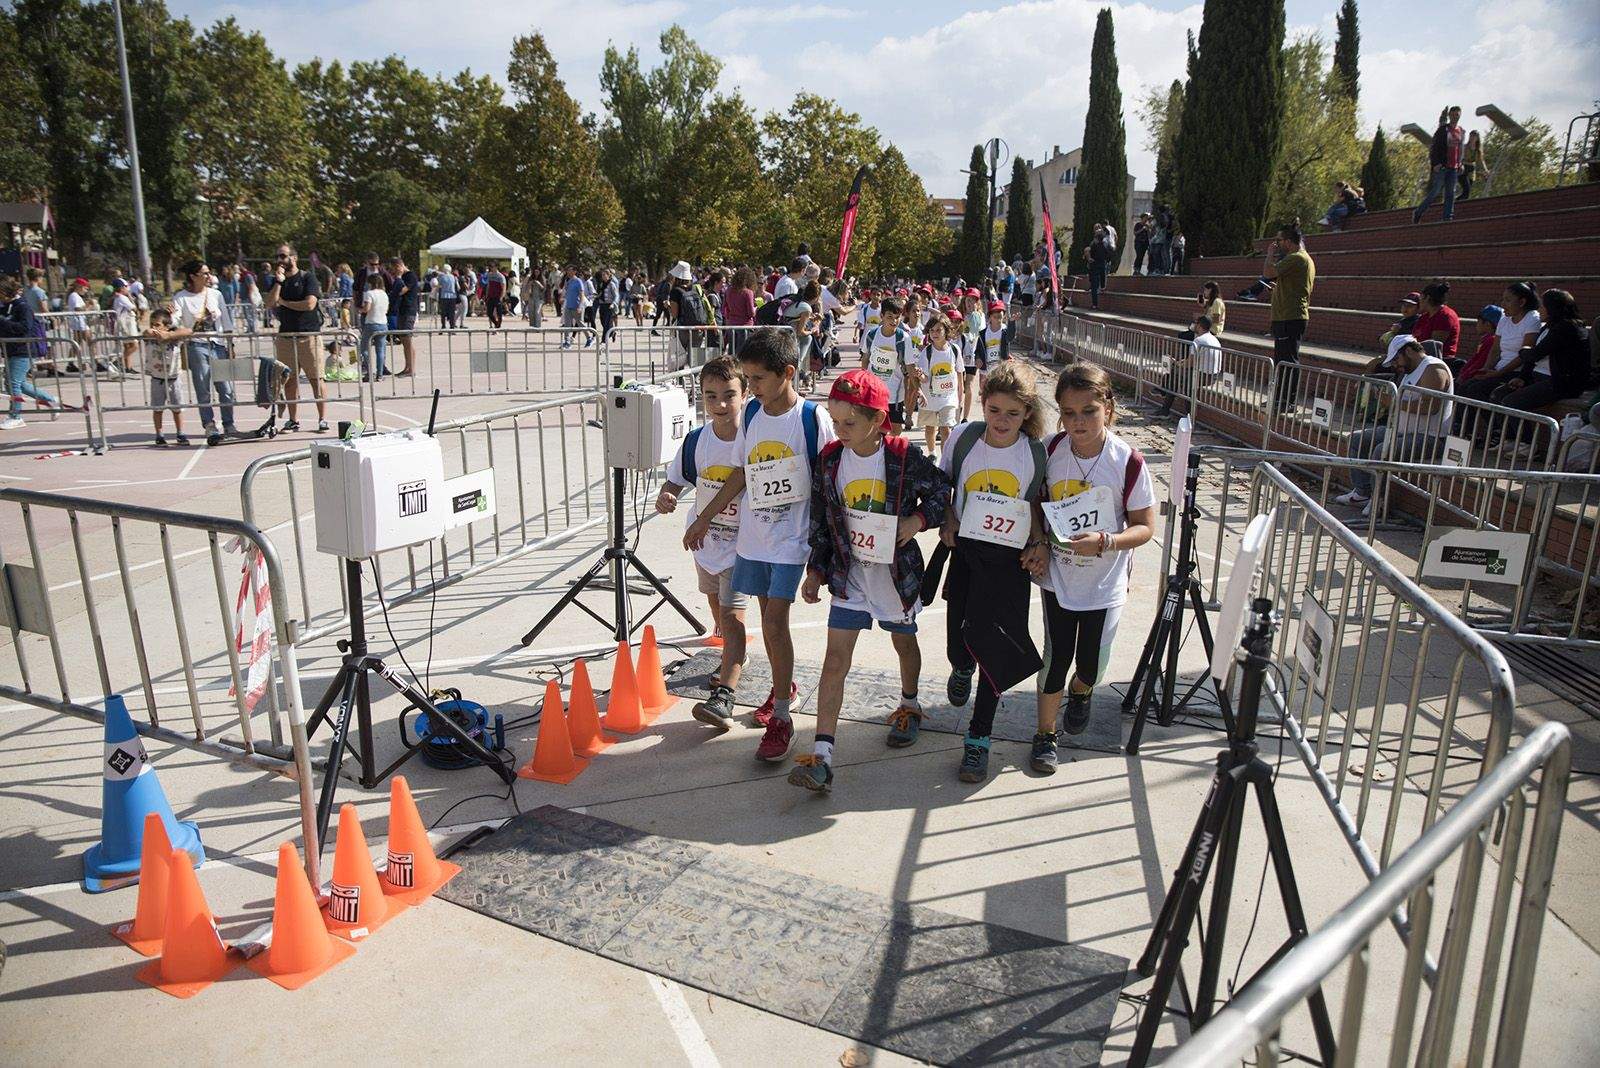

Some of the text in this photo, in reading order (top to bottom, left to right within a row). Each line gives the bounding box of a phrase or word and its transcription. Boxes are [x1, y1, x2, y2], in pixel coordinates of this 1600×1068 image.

[763, 478, 792, 496] 225
[399, 490, 427, 517] LIMIT
[719, 502, 738, 516] 25
[983, 514, 1016, 534] 327
[1069, 510, 1099, 531] 327
[851, 530, 875, 550] 224
[1453, 549, 1486, 557] Ajuntament
[1188, 831, 1213, 884] INNOX
[387, 860, 412, 887] IMIT
[330, 893, 358, 922] IMIT
